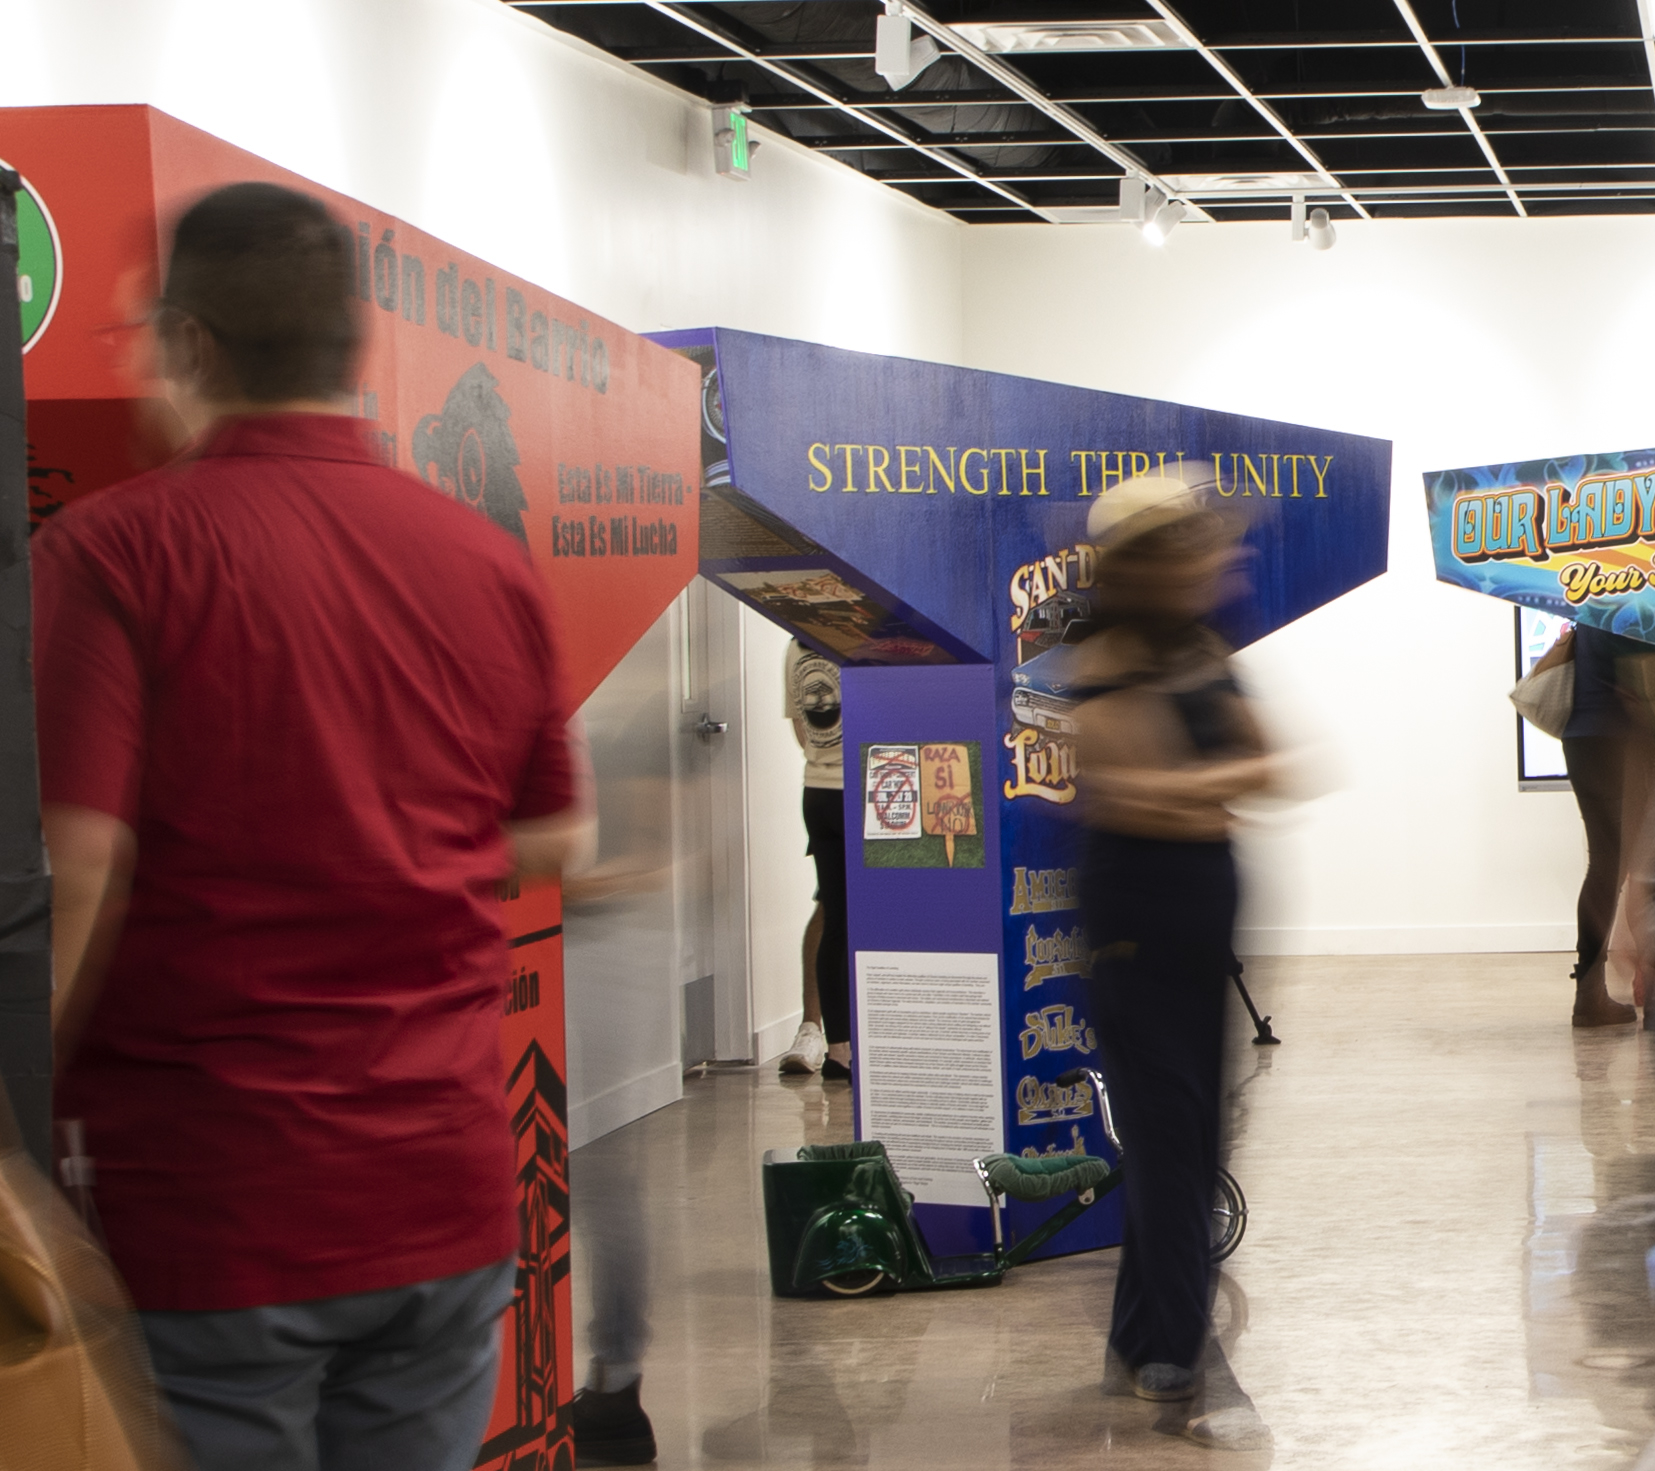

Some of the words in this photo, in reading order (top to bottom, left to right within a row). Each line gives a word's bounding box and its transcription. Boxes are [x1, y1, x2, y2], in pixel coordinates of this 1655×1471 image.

[436, 261, 497, 352] del
[506, 286, 610, 395] Barrio
[558, 462, 591, 504] Esta
[595, 462, 612, 504] Es
[616, 464, 634, 504] Mi
[637, 464, 684, 505] Tierra
[807, 443, 1050, 496] STRENGTH
[1212, 452, 1334, 498] UNITY
[552, 515, 586, 557] Esta
[589, 515, 607, 557] Es
[610, 515, 629, 556] Mi
[632, 515, 677, 556] Lucha
[1454, 490, 1541, 557] OUR
[1562, 564, 1643, 603] Your
